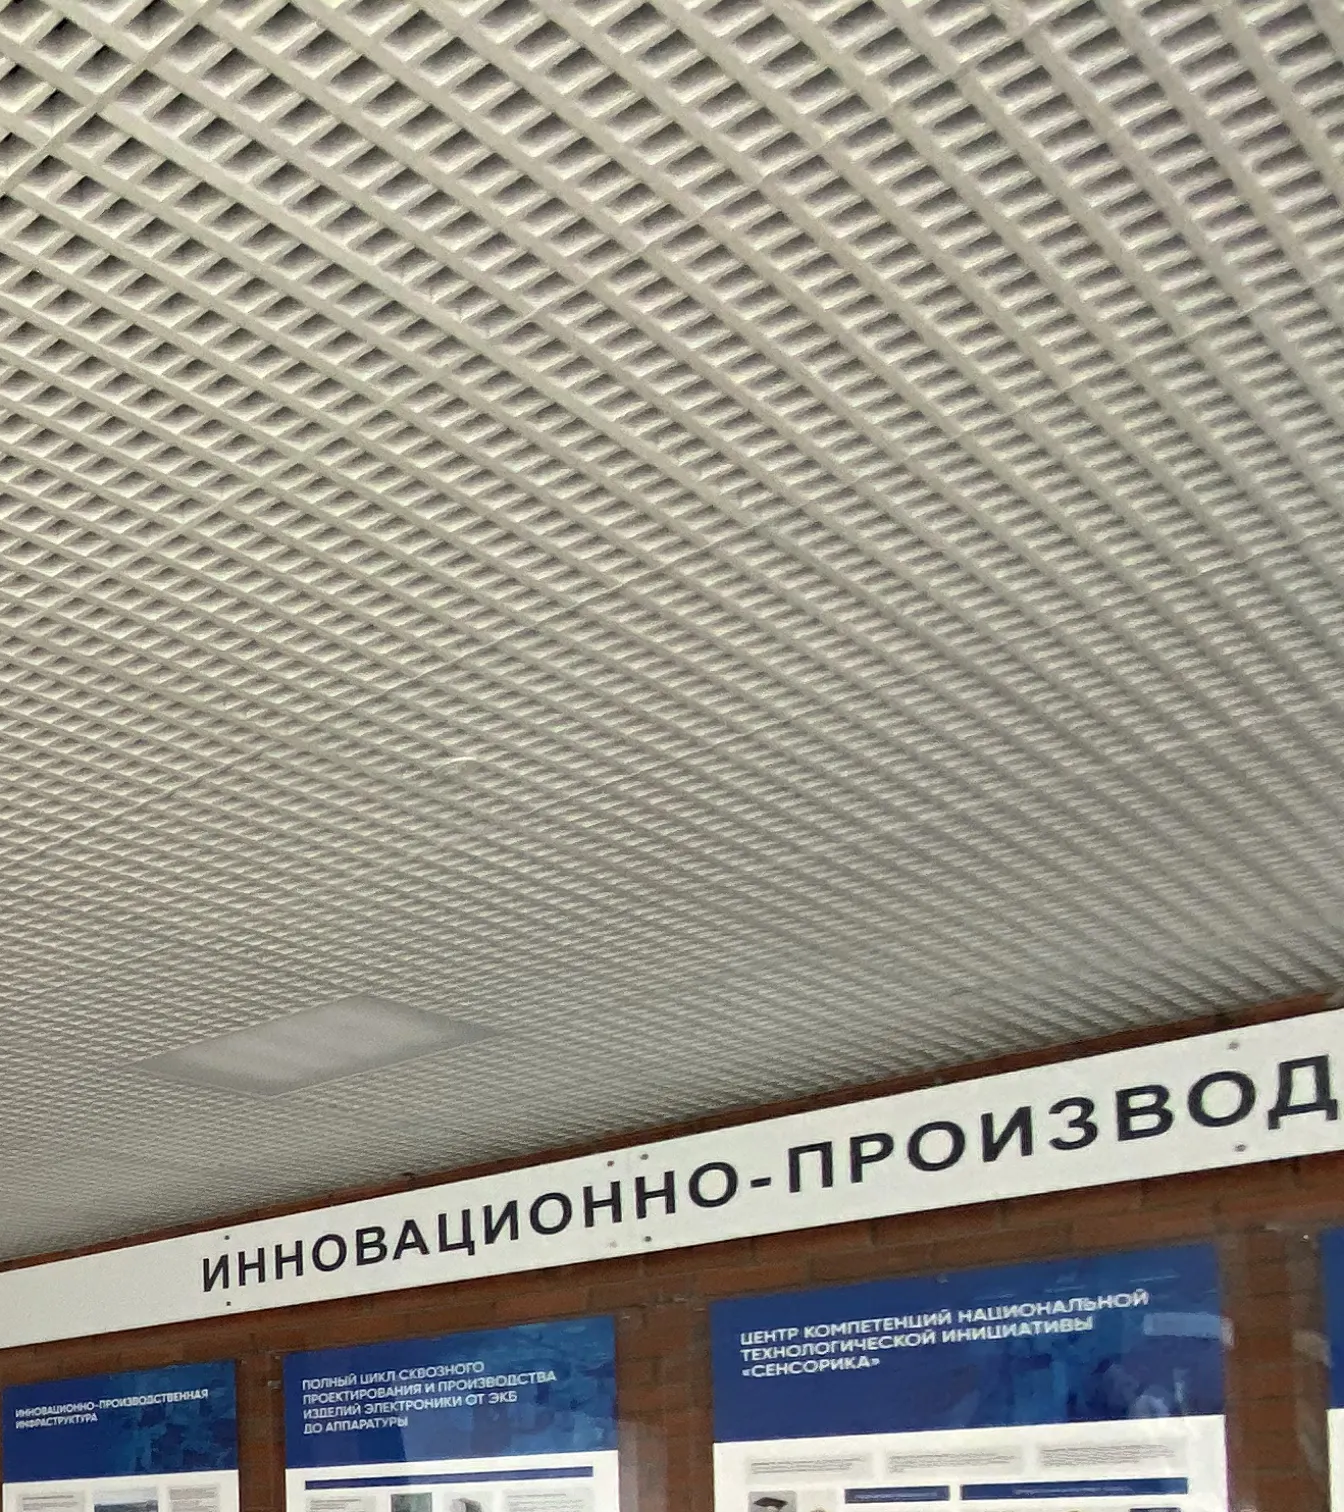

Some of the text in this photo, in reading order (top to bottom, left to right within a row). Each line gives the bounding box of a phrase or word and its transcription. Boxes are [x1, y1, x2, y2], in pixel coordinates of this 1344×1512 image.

[202, 1054, 1339, 1293] ИННОВАЦИОННО-ПРОИЗВОД
[740, 1289, 1150, 1346] ЦЕНТР КОМПЕТЕНЦИЙ НАЦИОНАЛЬНОЙ
[740, 1316, 1094, 1362] ТЕХНОЛОГИЧЕСКОЙ ИНИЦИАТИВЫ
[302, 1361, 485, 1391] ПОЛНЫЙ ЦИКЛ СКВОЗНОГО
[741, 1354, 881, 1379] «СЕНСОРИКА»
[303, 1370, 557, 1406] ПРОЕКТИРОВАНИЯ И ПРОИЗВОДСТВА
[303, 1390, 518, 1420] ИЗДЕЛИЙ ЭЛЕКТРОНИКИ ОТ ЭКБ
[15, 1412, 98, 1429] ИНФРАСТРУКТУРА
[303, 1416, 409, 1435] ДО АППАРАТУРЫ
